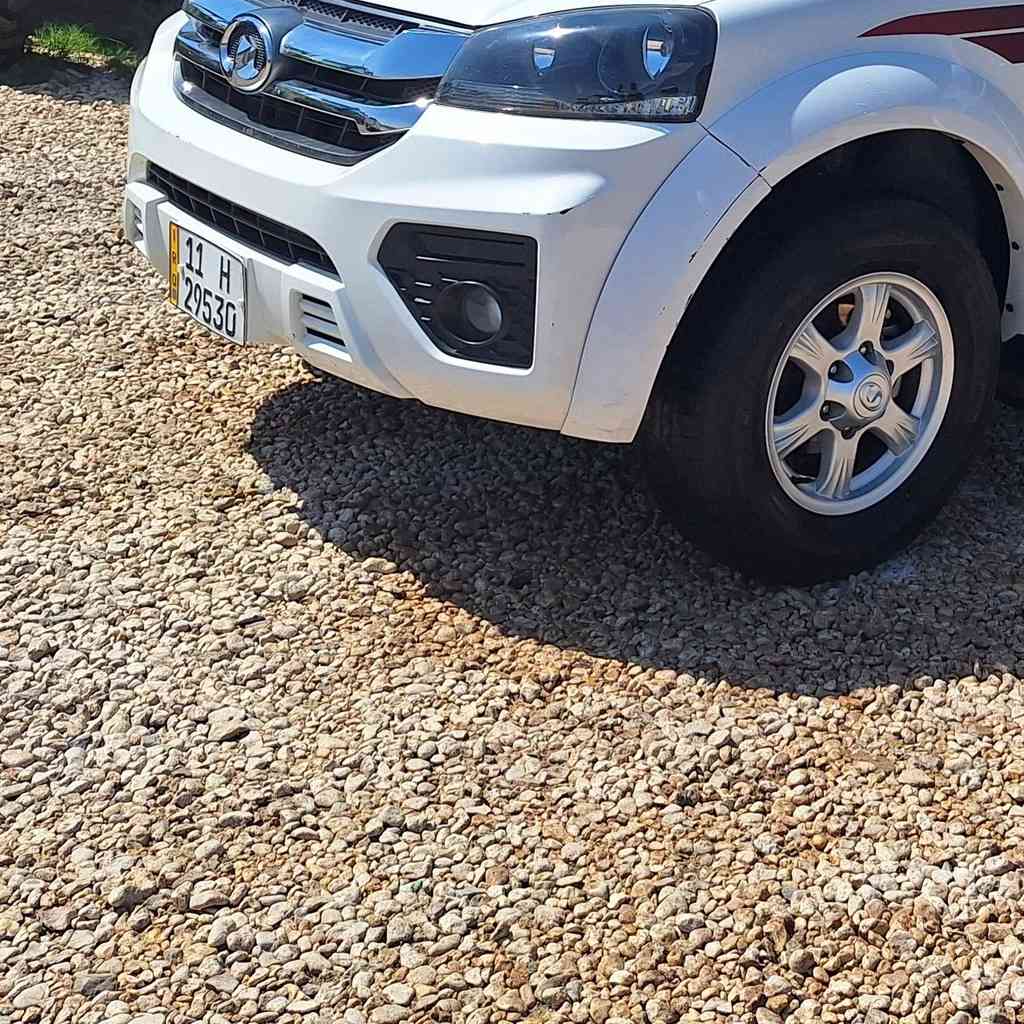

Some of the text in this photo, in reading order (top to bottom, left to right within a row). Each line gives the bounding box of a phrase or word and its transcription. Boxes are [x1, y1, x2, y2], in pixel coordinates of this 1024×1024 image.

[185, 237, 230, 294] 11 H
[185, 276, 236, 337] 29530
